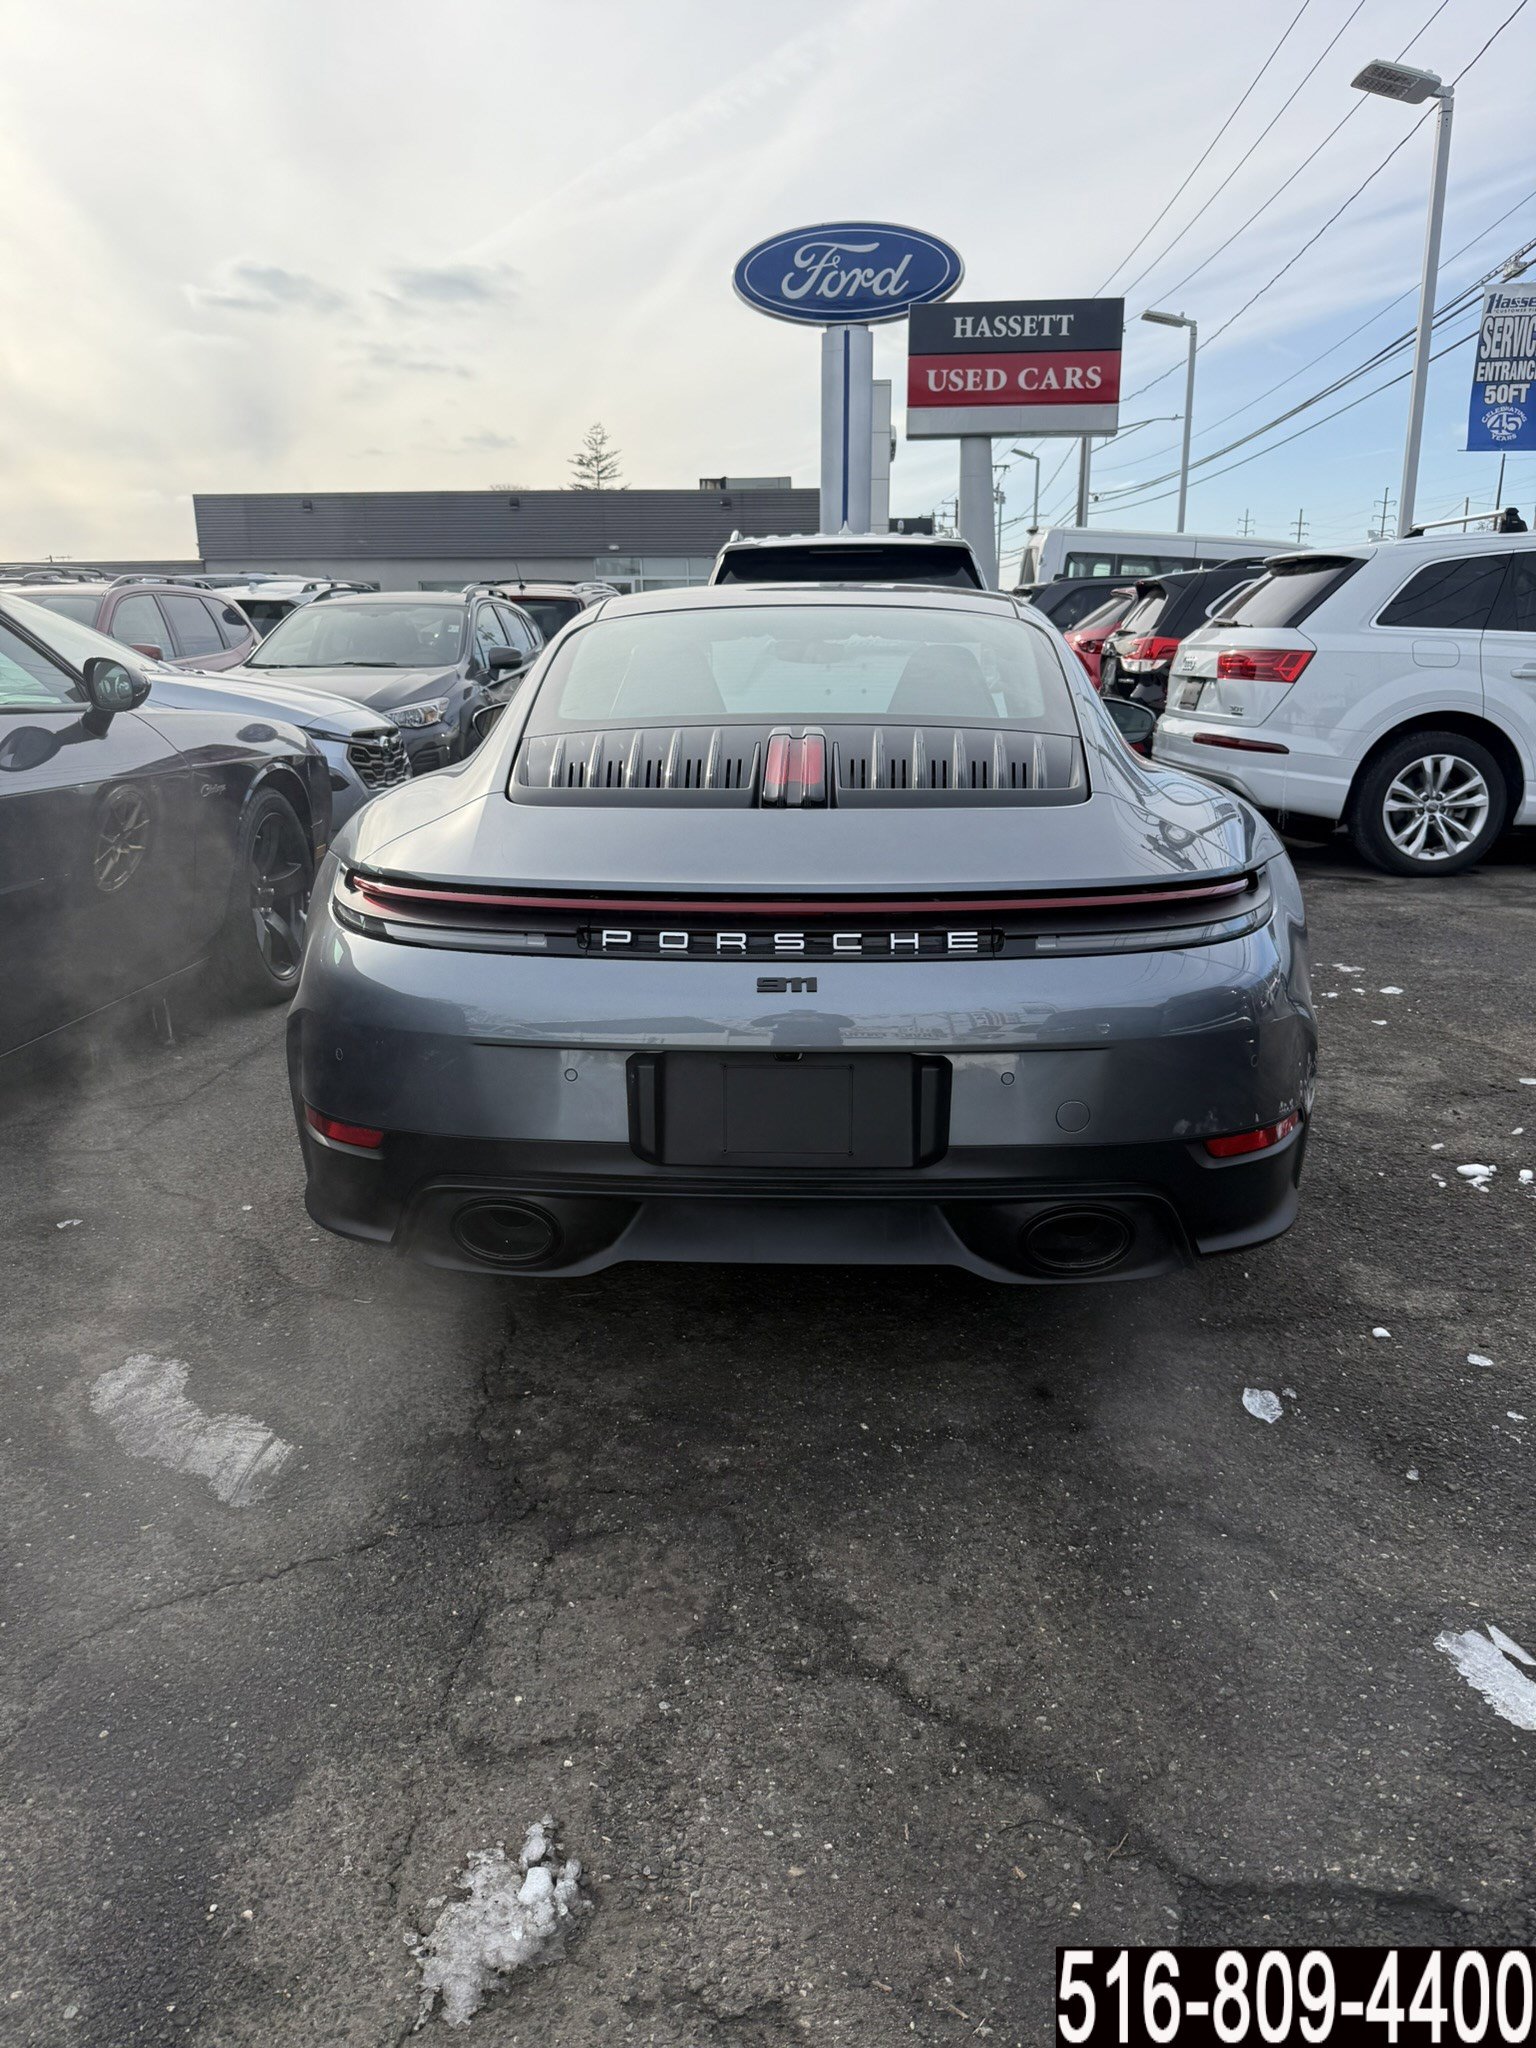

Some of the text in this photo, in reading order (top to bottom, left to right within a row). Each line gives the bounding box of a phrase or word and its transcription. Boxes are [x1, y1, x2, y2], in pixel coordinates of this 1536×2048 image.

[781, 241, 913, 299] Ford
[953, 314, 1074, 338] HASSETT
[1480, 314, 1536, 359] SERVIC
[926, 366, 1102, 393] USED CARS
[1475, 359, 1536, 382] ENTRANC
[1484, 383, 1531, 405] 50FT
[1481, 406, 1528, 423] CELEBRATING
[1489, 413, 1520, 434] 45
[1491, 432, 1517, 442] YEARS
[602, 929, 978, 951] PORSCHE
[756, 976, 818, 993] 911
